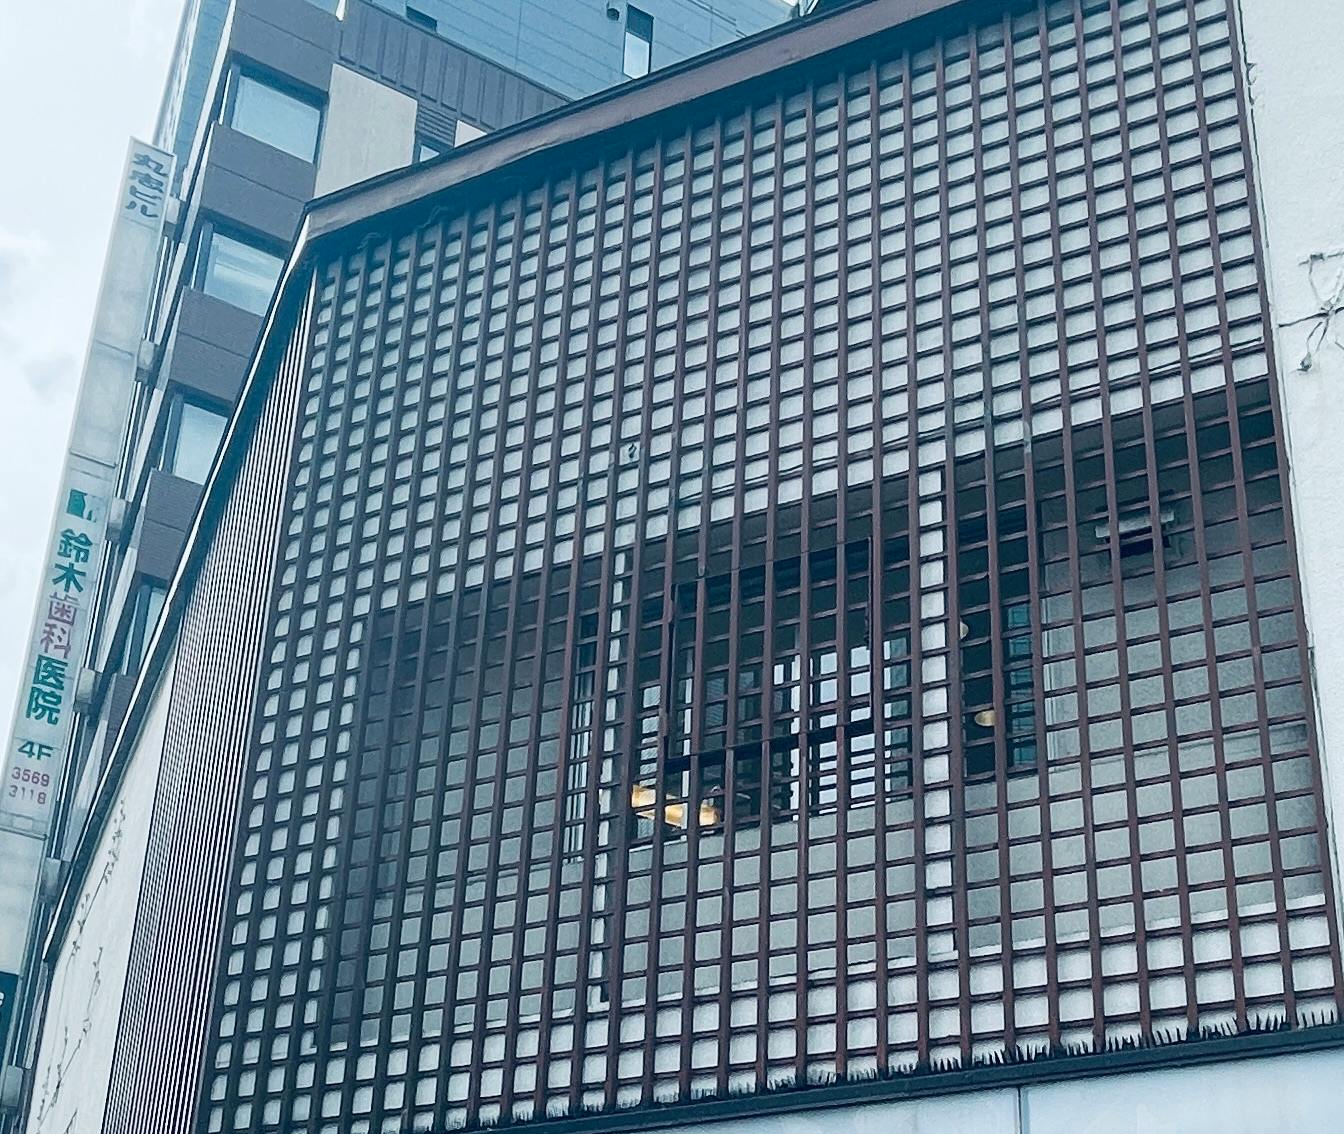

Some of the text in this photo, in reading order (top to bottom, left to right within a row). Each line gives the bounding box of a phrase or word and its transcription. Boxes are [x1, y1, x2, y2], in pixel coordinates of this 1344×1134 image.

[25, 527, 94, 727] 鈴木歯科医院
[17, 739, 55, 761] 4F
